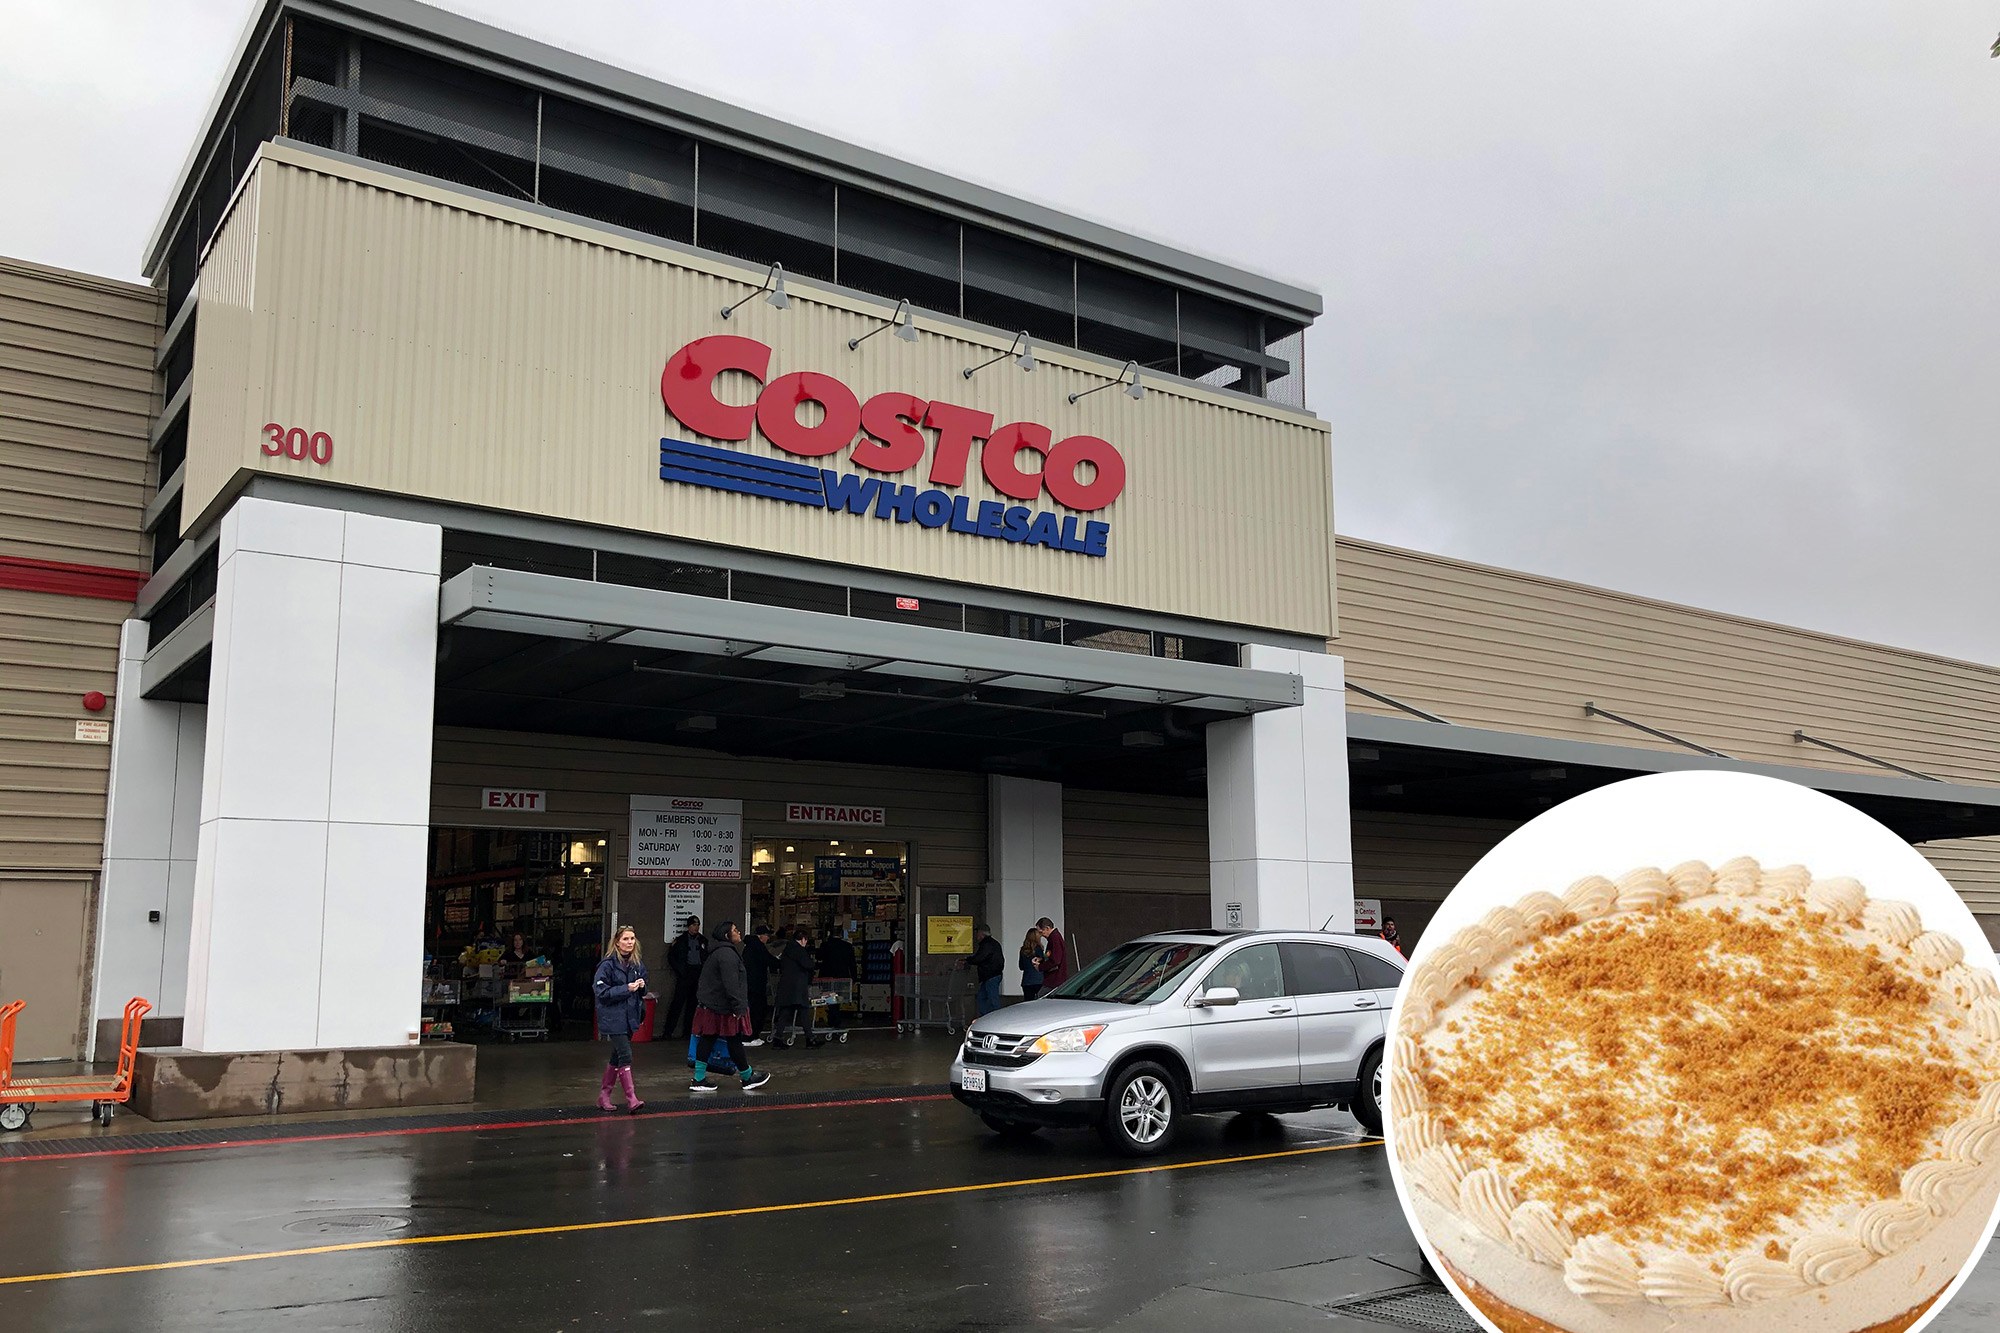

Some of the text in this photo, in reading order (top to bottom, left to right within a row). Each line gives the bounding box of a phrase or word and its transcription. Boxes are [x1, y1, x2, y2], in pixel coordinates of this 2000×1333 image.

[661, 334, 1126, 511] COSTCO
[261, 423, 334, 465] 300
[821, 468, 1110, 557] WHOLESALE
[488, 792, 539, 808] EXIT
[656, 815, 718, 825] MEMBERS ONLY
[789, 805, 883, 823] ENTRANCE
[638, 828, 658, 837] MON
[664, 829, 678, 838] FRI
[692, 829, 712, 839] 10:00
[718, 830, 734, 839] 8:30
[638, 842, 680, 852] SATURDAY
[695, 844, 712, 853] 9:30
[718, 845, 734, 854] 7:00
[637, 856, 671, 866] SUNDAY
[691, 858, 711, 867] 10:00
[717, 859, 733, 868] 7:00
[819, 860, 895, 869] FREE Technical Support
